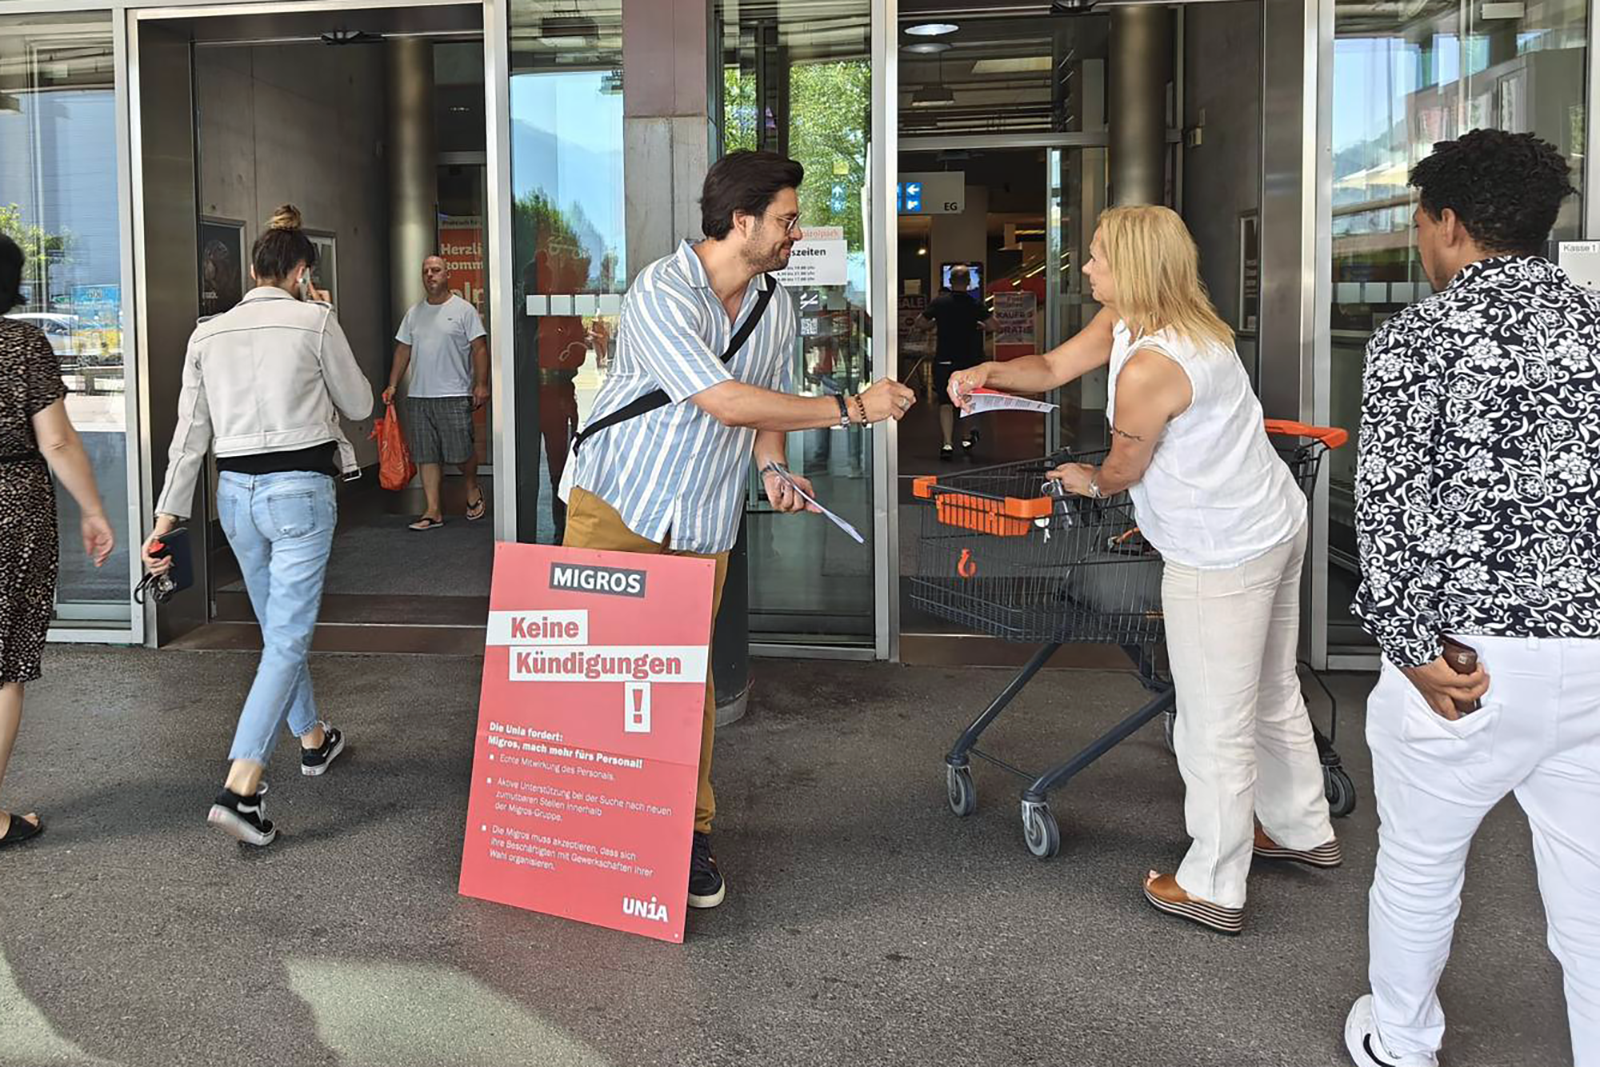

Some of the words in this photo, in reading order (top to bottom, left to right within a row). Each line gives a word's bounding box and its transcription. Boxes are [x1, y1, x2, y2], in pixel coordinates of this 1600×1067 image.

[944, 202, 958, 211] EG
[552, 567, 641, 593] MIGROS
[511, 616, 579, 639] Keine
[516, 650, 682, 679] Kündigungen
[632, 688, 643, 724] !
[489, 721, 505, 733] Die
[505, 724, 526, 736] Unia
[527, 727, 563, 742] fordert:
[488, 735, 521, 750] Migros,
[522, 742, 547, 753] mach
[574, 749, 595, 761] fürs
[596, 752, 643, 769] Personal!
[561, 766, 576, 775] des
[600, 795, 625, 808] Suche
[625, 801, 646, 811] nach
[646, 805, 673, 817] neuen
[505, 827, 530, 841] Migros
[531, 834, 552, 845] muss
[599, 846, 620, 858] dass
[619, 850, 637, 861] sich
[570, 852, 633, 874] Gewerkschaften
